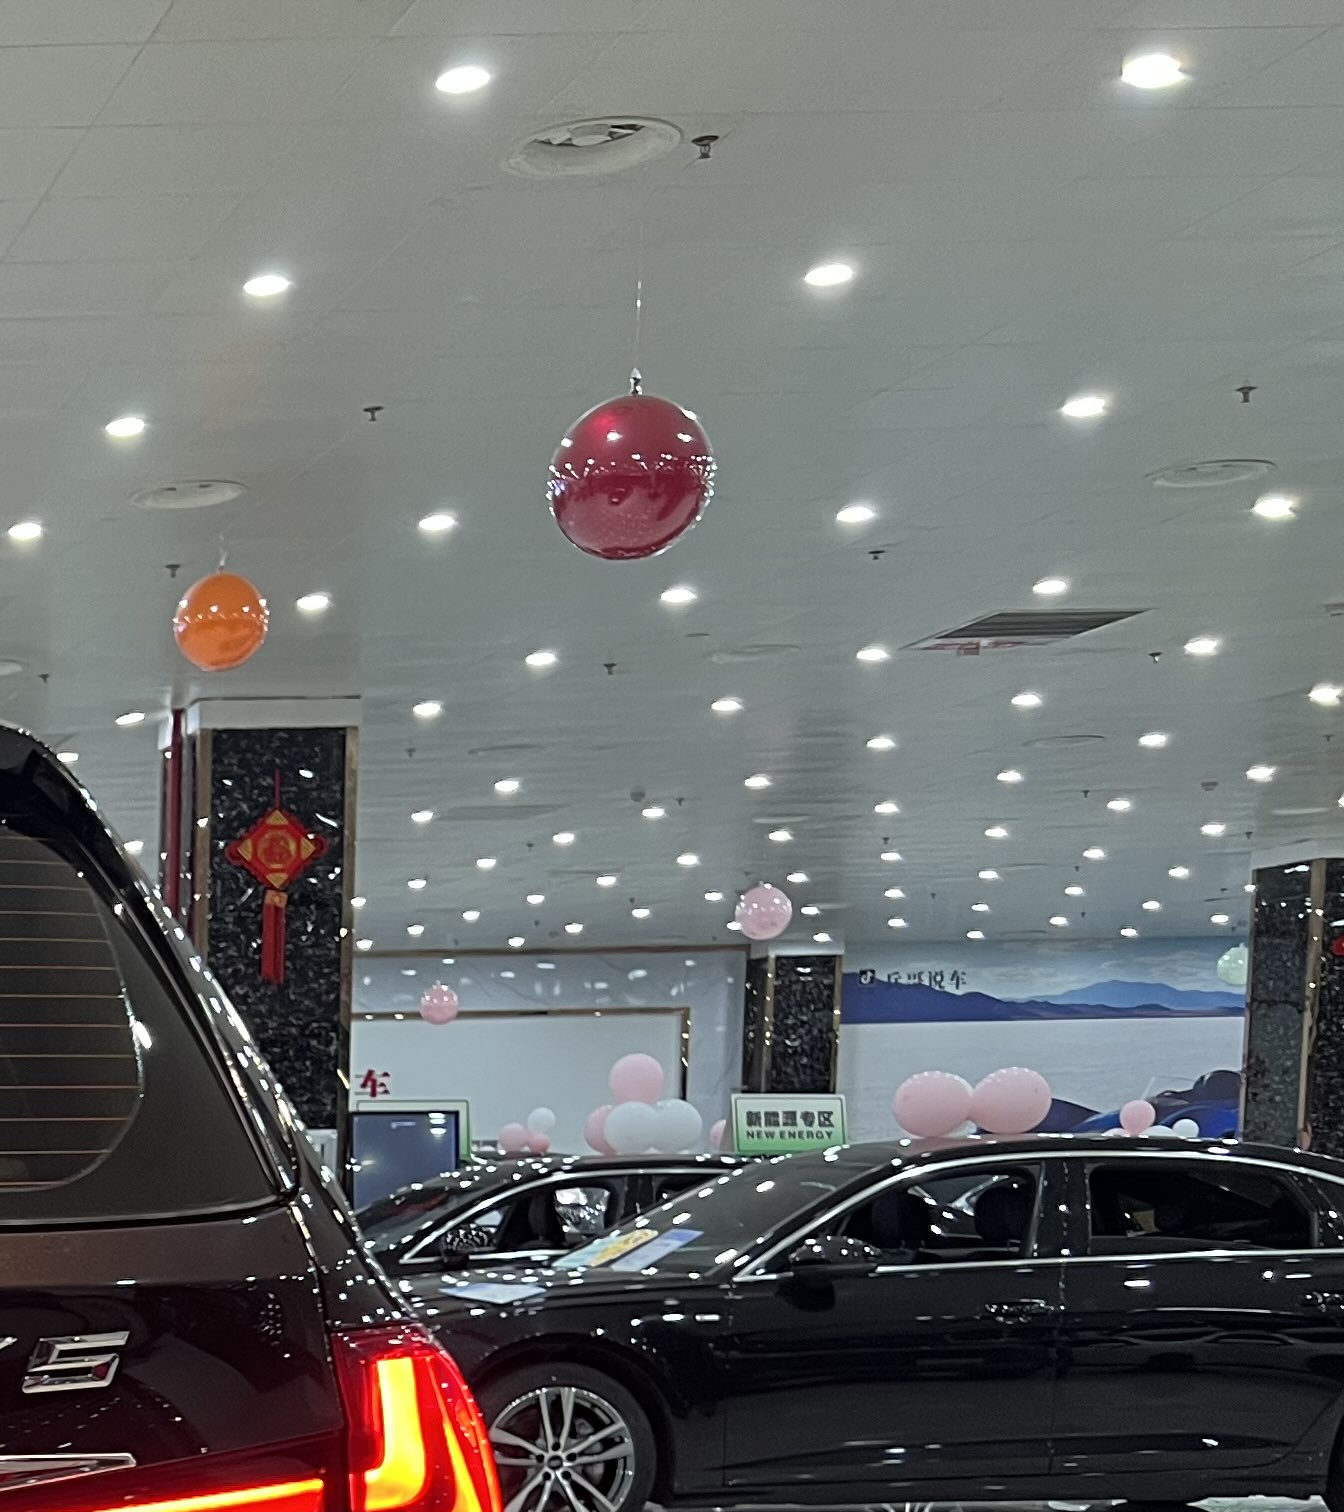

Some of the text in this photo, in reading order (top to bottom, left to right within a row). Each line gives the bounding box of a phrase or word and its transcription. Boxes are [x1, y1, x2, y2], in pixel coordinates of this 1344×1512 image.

[354, 1069, 391, 1098] 车
[746, 1130, 833, 1140] NEW ENERGY
